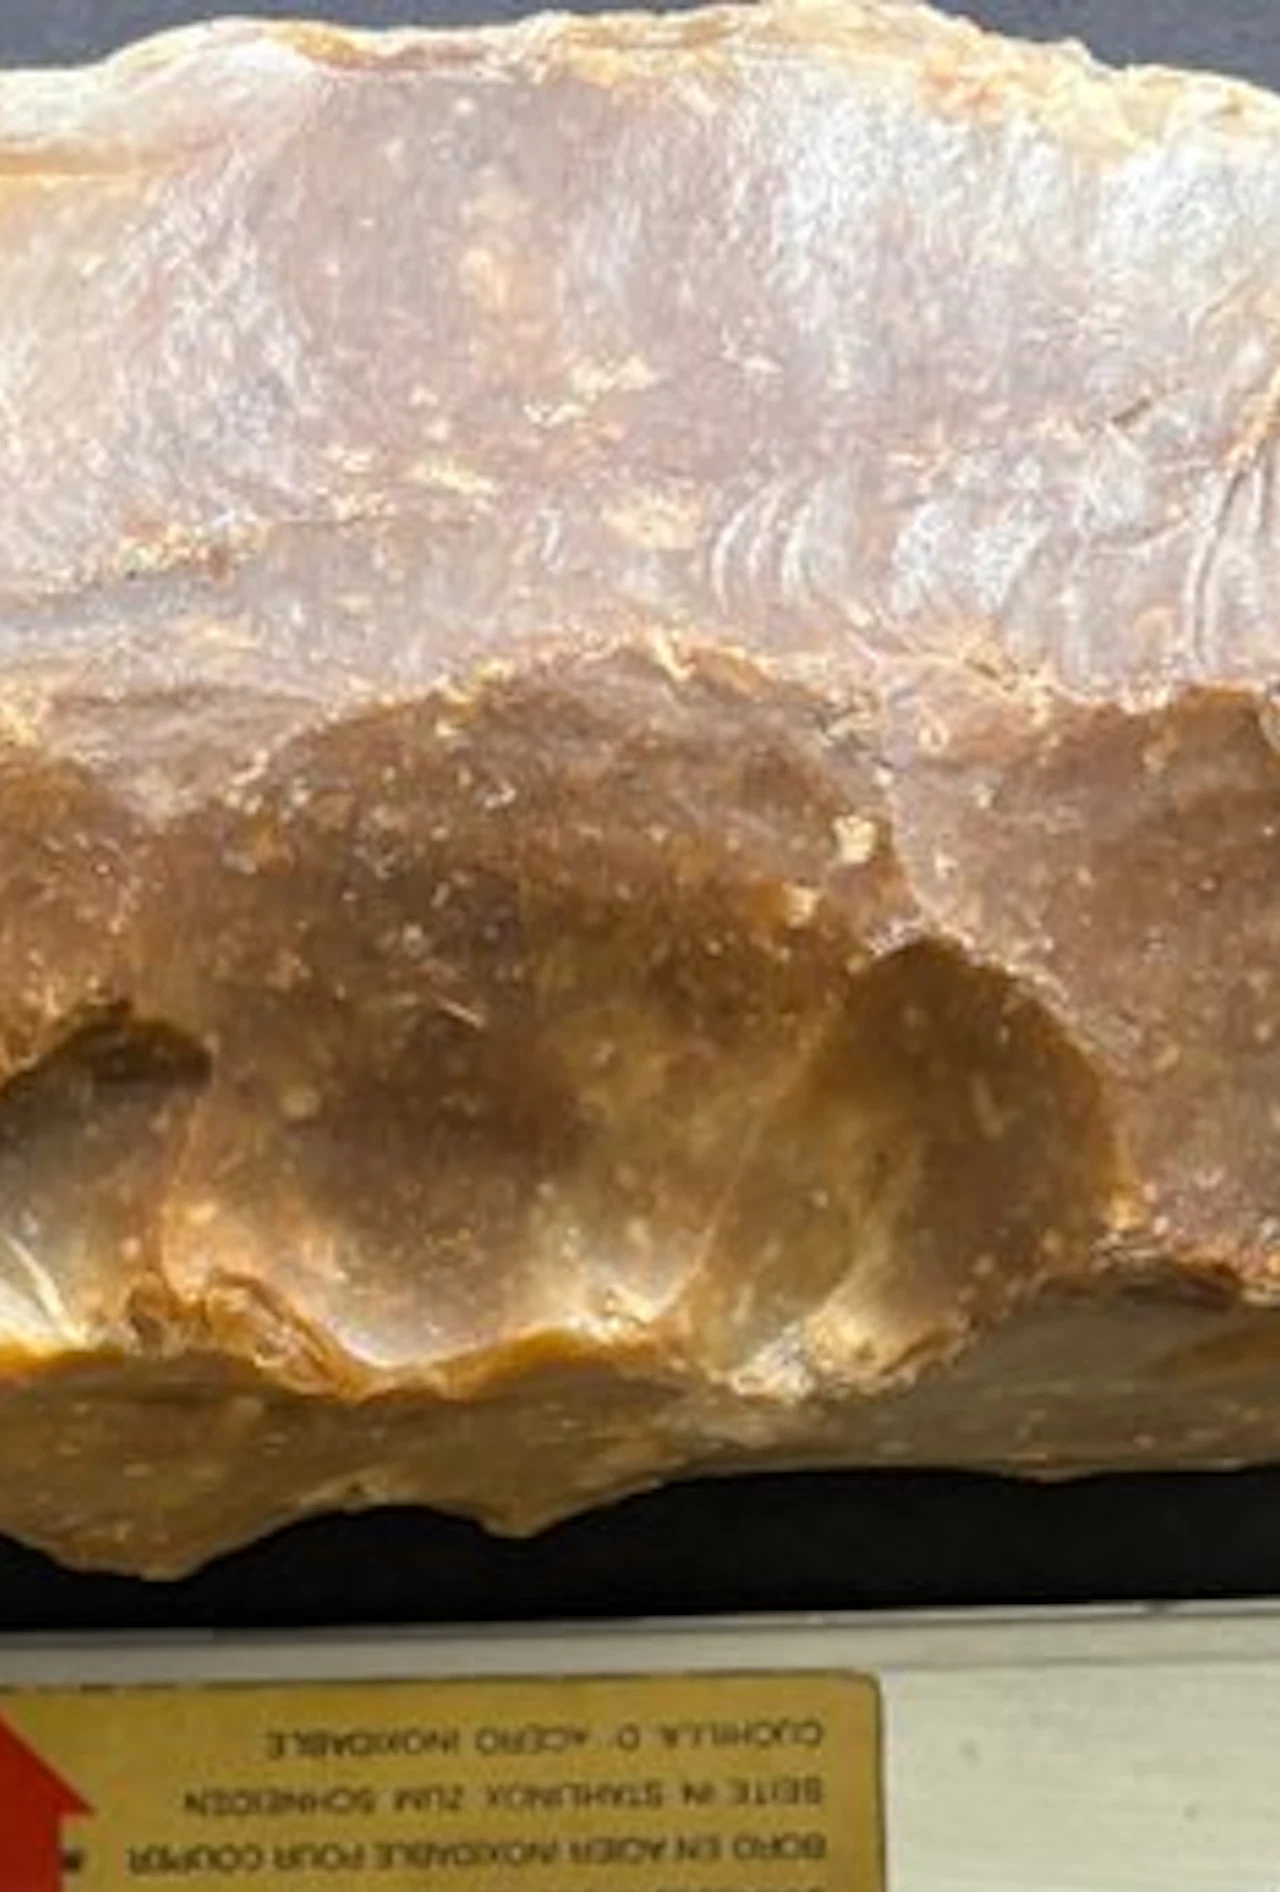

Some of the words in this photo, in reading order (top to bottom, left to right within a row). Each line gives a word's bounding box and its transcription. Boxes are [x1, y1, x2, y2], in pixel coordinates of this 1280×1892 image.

[265, 1729, 461, 1759] INOXIDABLE
[476, 1726, 589, 1756] ACERO
[661, 1720, 825, 1750] CUCHILLA
[183, 1787, 375, 1817] SCHNEIDEN
[393, 1783, 466, 1812] ZUM
[681, 1779, 717, 1805] IN
[127, 1844, 262, 1874] COUPER
[273, 1843, 364, 1872] POUR
[372, 1839, 560, 1869] INOXIDABLE
[568, 1837, 666, 1865] ACIER
[677, 1836, 721, 1861] EN
